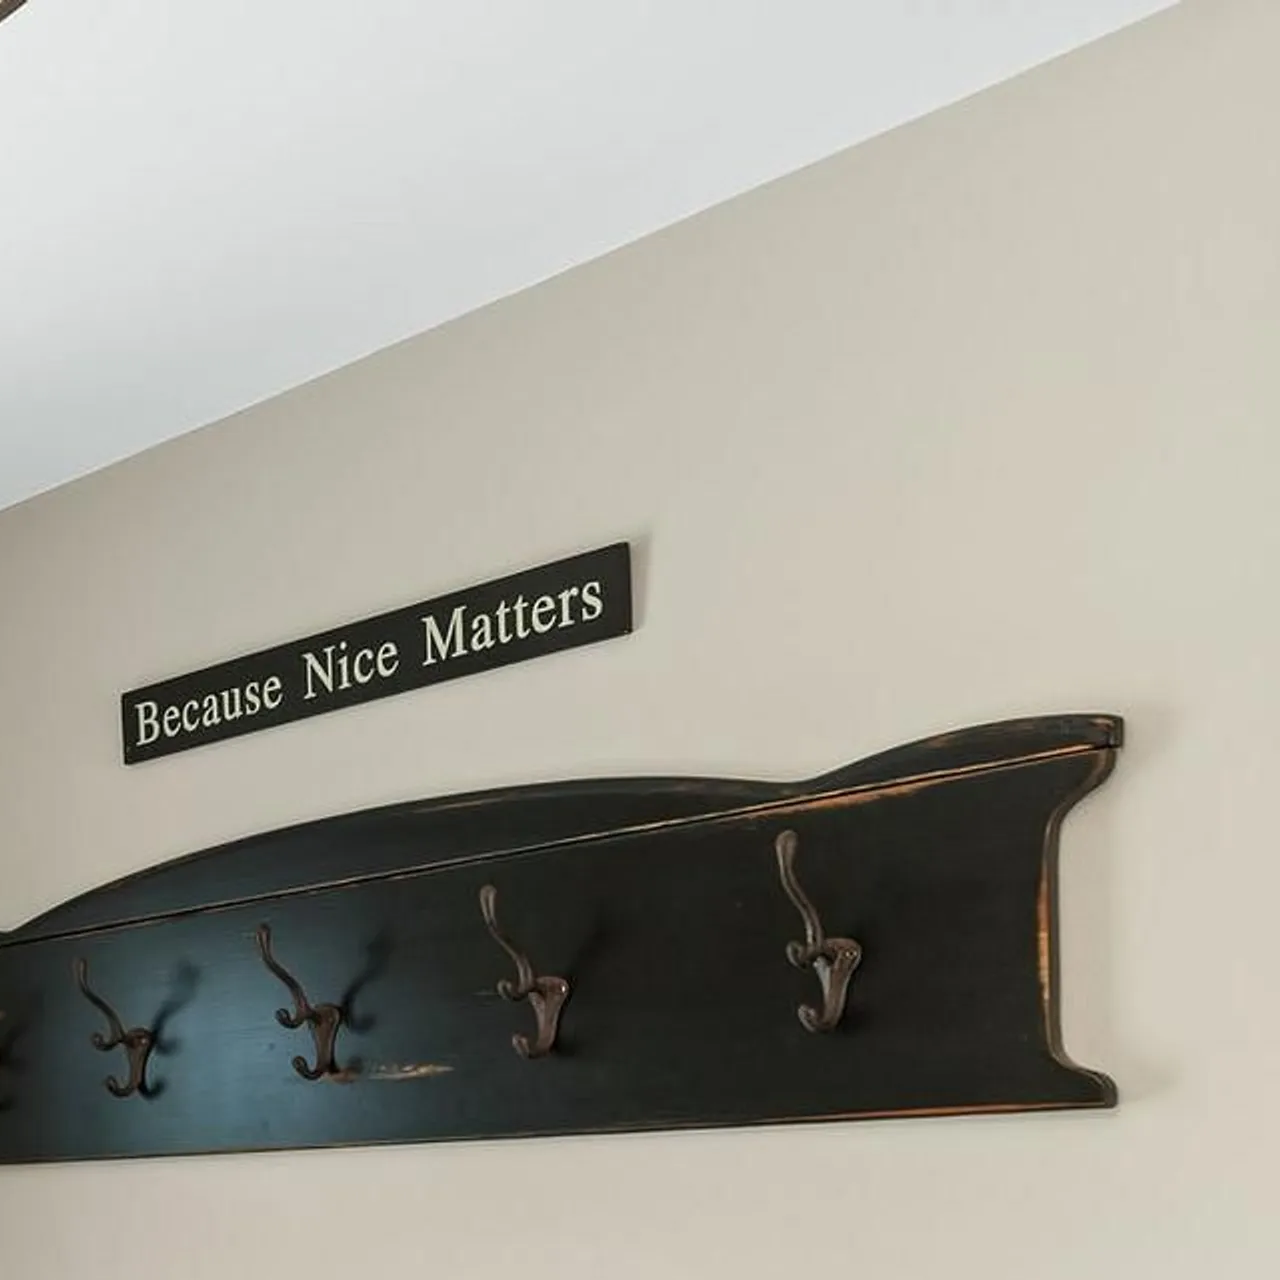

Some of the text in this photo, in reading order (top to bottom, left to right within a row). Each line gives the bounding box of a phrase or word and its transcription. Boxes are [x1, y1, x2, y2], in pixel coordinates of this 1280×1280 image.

[135, 579, 605, 746] Because Nice Matters
